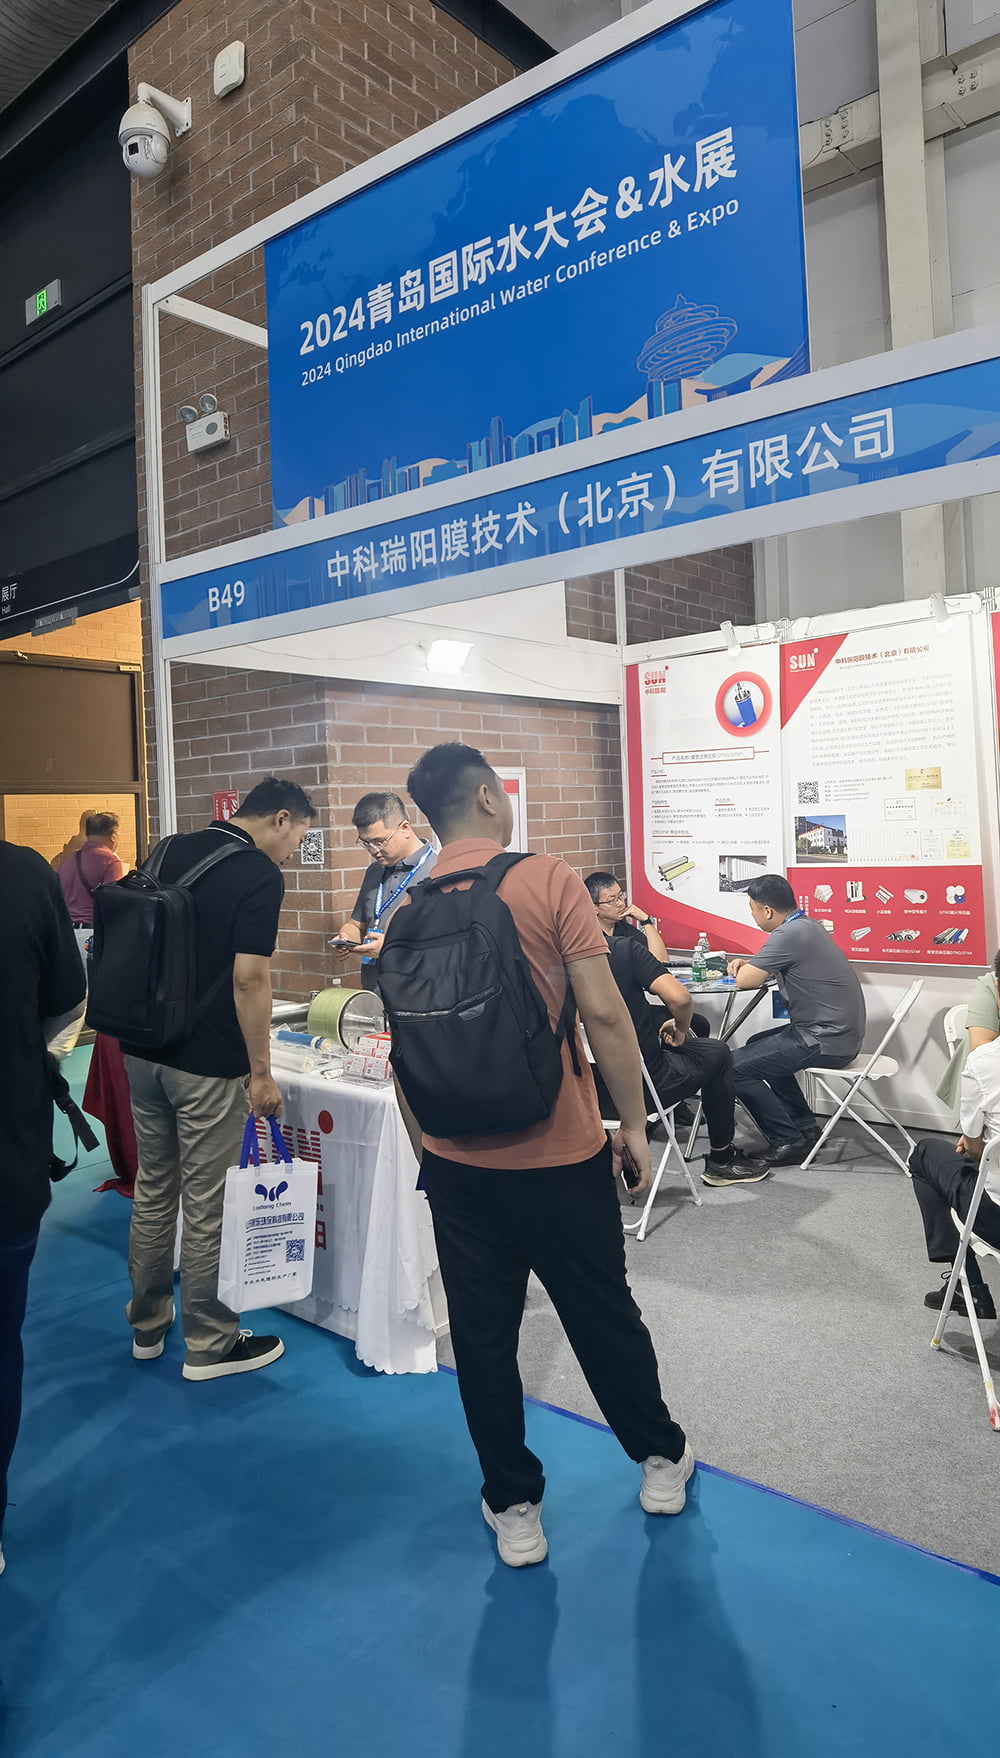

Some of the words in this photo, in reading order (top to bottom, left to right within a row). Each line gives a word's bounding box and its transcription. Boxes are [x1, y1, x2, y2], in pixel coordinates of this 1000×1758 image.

[299, 126, 738, 356] 2024青岛国际水大会&水展
[301, 362, 332, 386] 2024
[335, 339, 392, 373] Qingdao
[397, 292, 496, 348] International
[500, 273, 551, 304] Water
[555, 230, 662, 283] Conference
[667, 220, 682, 239] &
[687, 199, 739, 233] Expo
[2, 582, 18, 601] 展厅
[208, 580, 245, 612] B49
[789, 653, 816, 669] SUN
[644, 670, 666, 685] SUN
